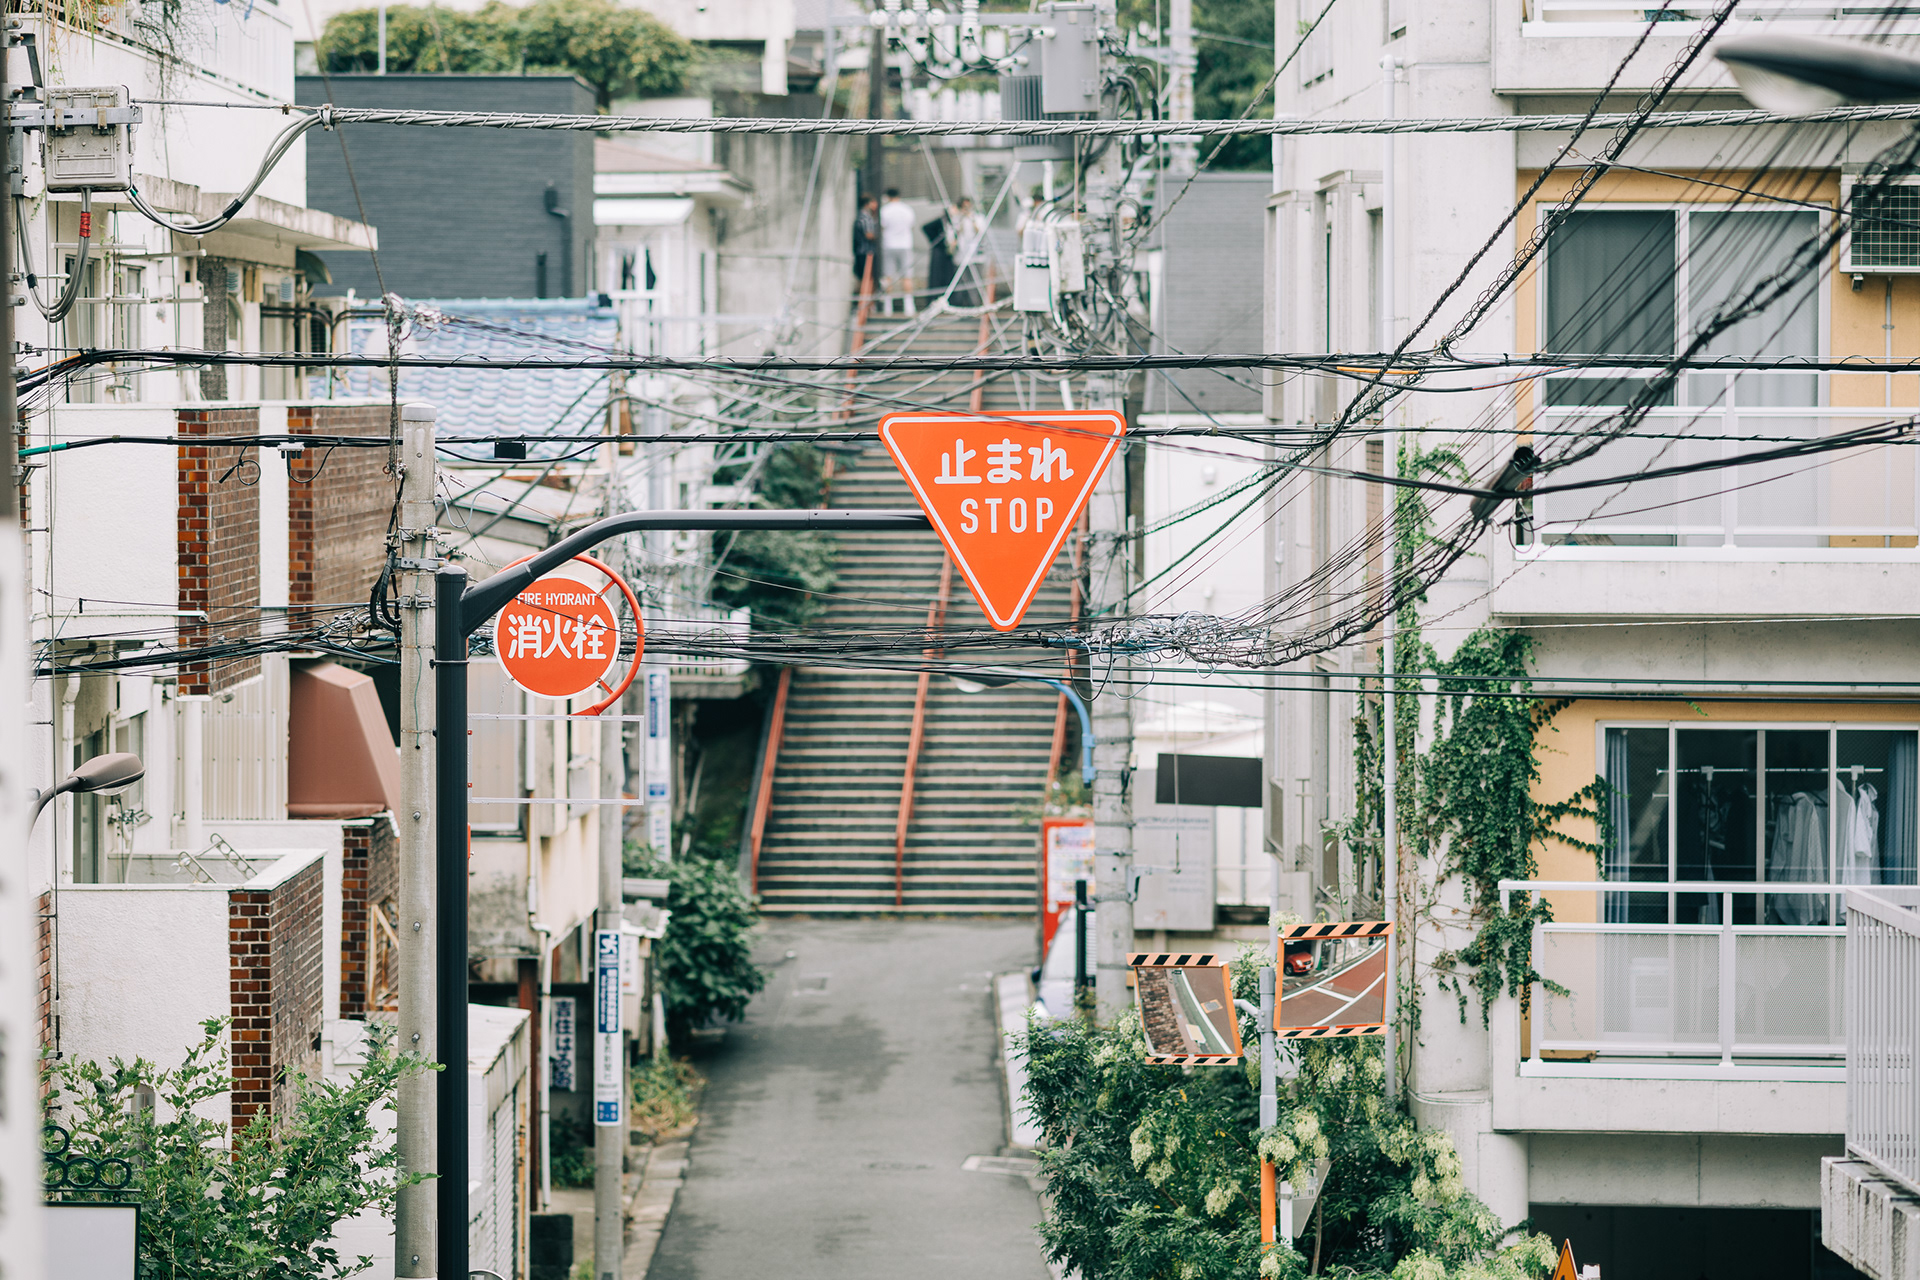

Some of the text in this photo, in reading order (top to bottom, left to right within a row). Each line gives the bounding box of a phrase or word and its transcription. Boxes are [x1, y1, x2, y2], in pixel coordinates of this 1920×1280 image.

[934, 437, 1074, 484] 止まれ
[960, 498, 1053, 534] STOP
[517, 593, 597, 606] FIRE HYDRANT
[507, 613, 607, 660] 消火栓
